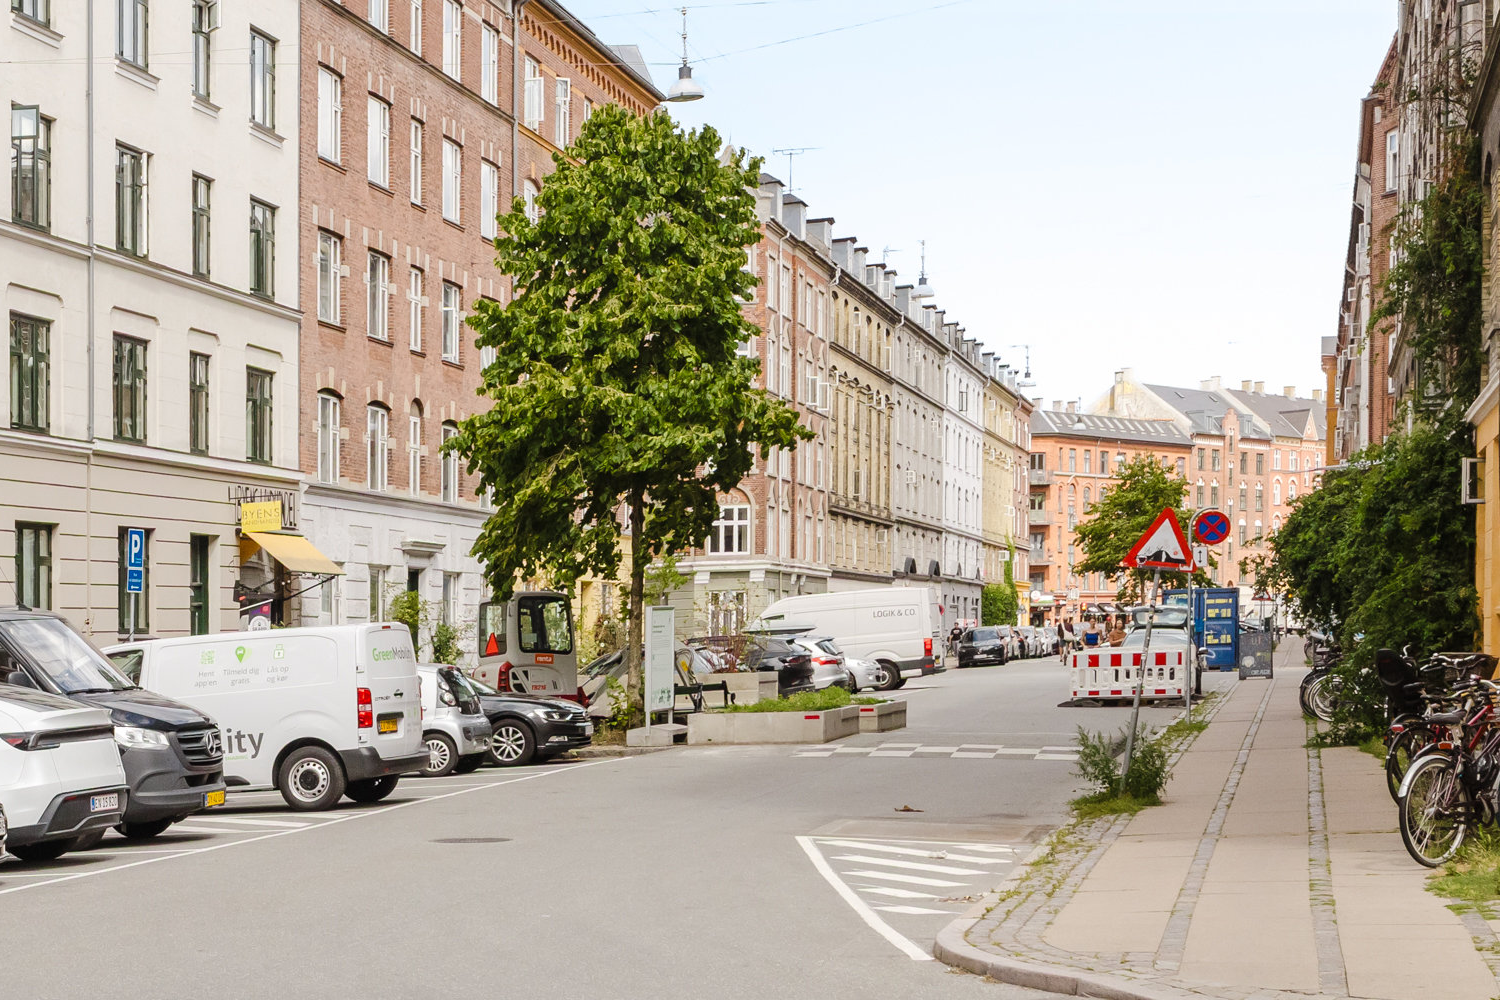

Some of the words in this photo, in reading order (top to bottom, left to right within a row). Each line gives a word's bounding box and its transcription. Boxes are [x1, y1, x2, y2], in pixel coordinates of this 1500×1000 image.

[242, 507, 280, 520] BYENS
[131, 534, 141, 564] P
[873, 609, 896, 618] LOGIK
[904, 608, 916, 616] CO.
[223, 668, 247, 676] Tilmeld
[248, 667, 260, 676] dig
[279, 665, 289, 674] op
[230, 678, 250, 687] gratis
